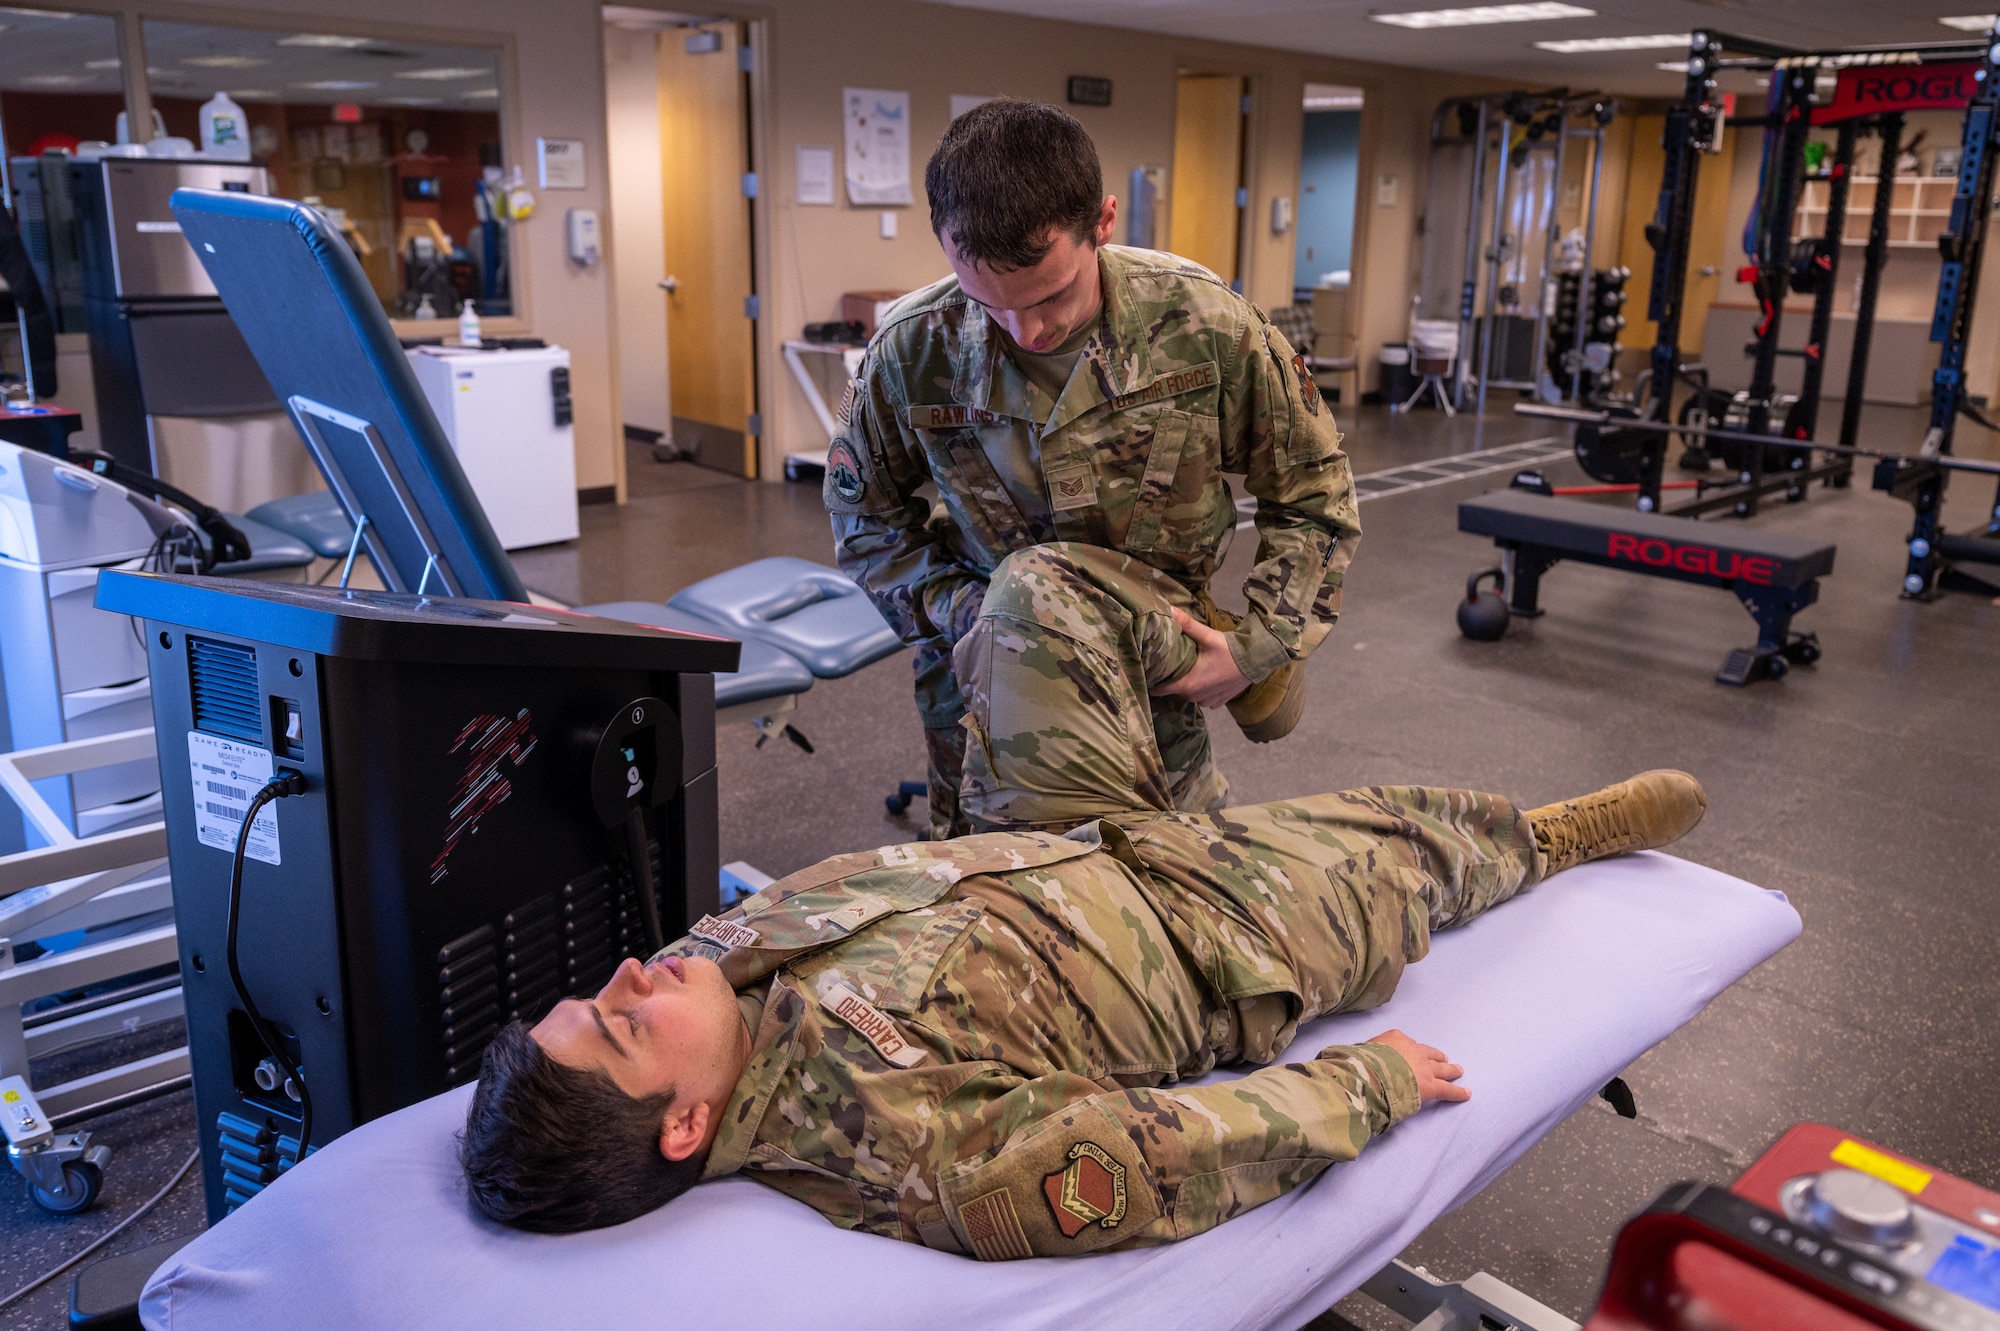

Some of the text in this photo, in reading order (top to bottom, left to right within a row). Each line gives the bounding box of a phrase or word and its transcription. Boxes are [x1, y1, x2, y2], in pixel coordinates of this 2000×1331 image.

[1142, 380, 1164, 402] AIR
[1166, 367, 1213, 395] FORCE
[931, 406, 994, 424] RAWLINS
[1607, 532, 1774, 587] ROGUE
[194, 736, 263, 758] GAME READY
[716, 922, 740, 943] AIR
[835, 996, 903, 1057] CARRERO
[1083, 1144, 1106, 1162] WING
[1104, 1159, 1125, 1197] FIGHTER
